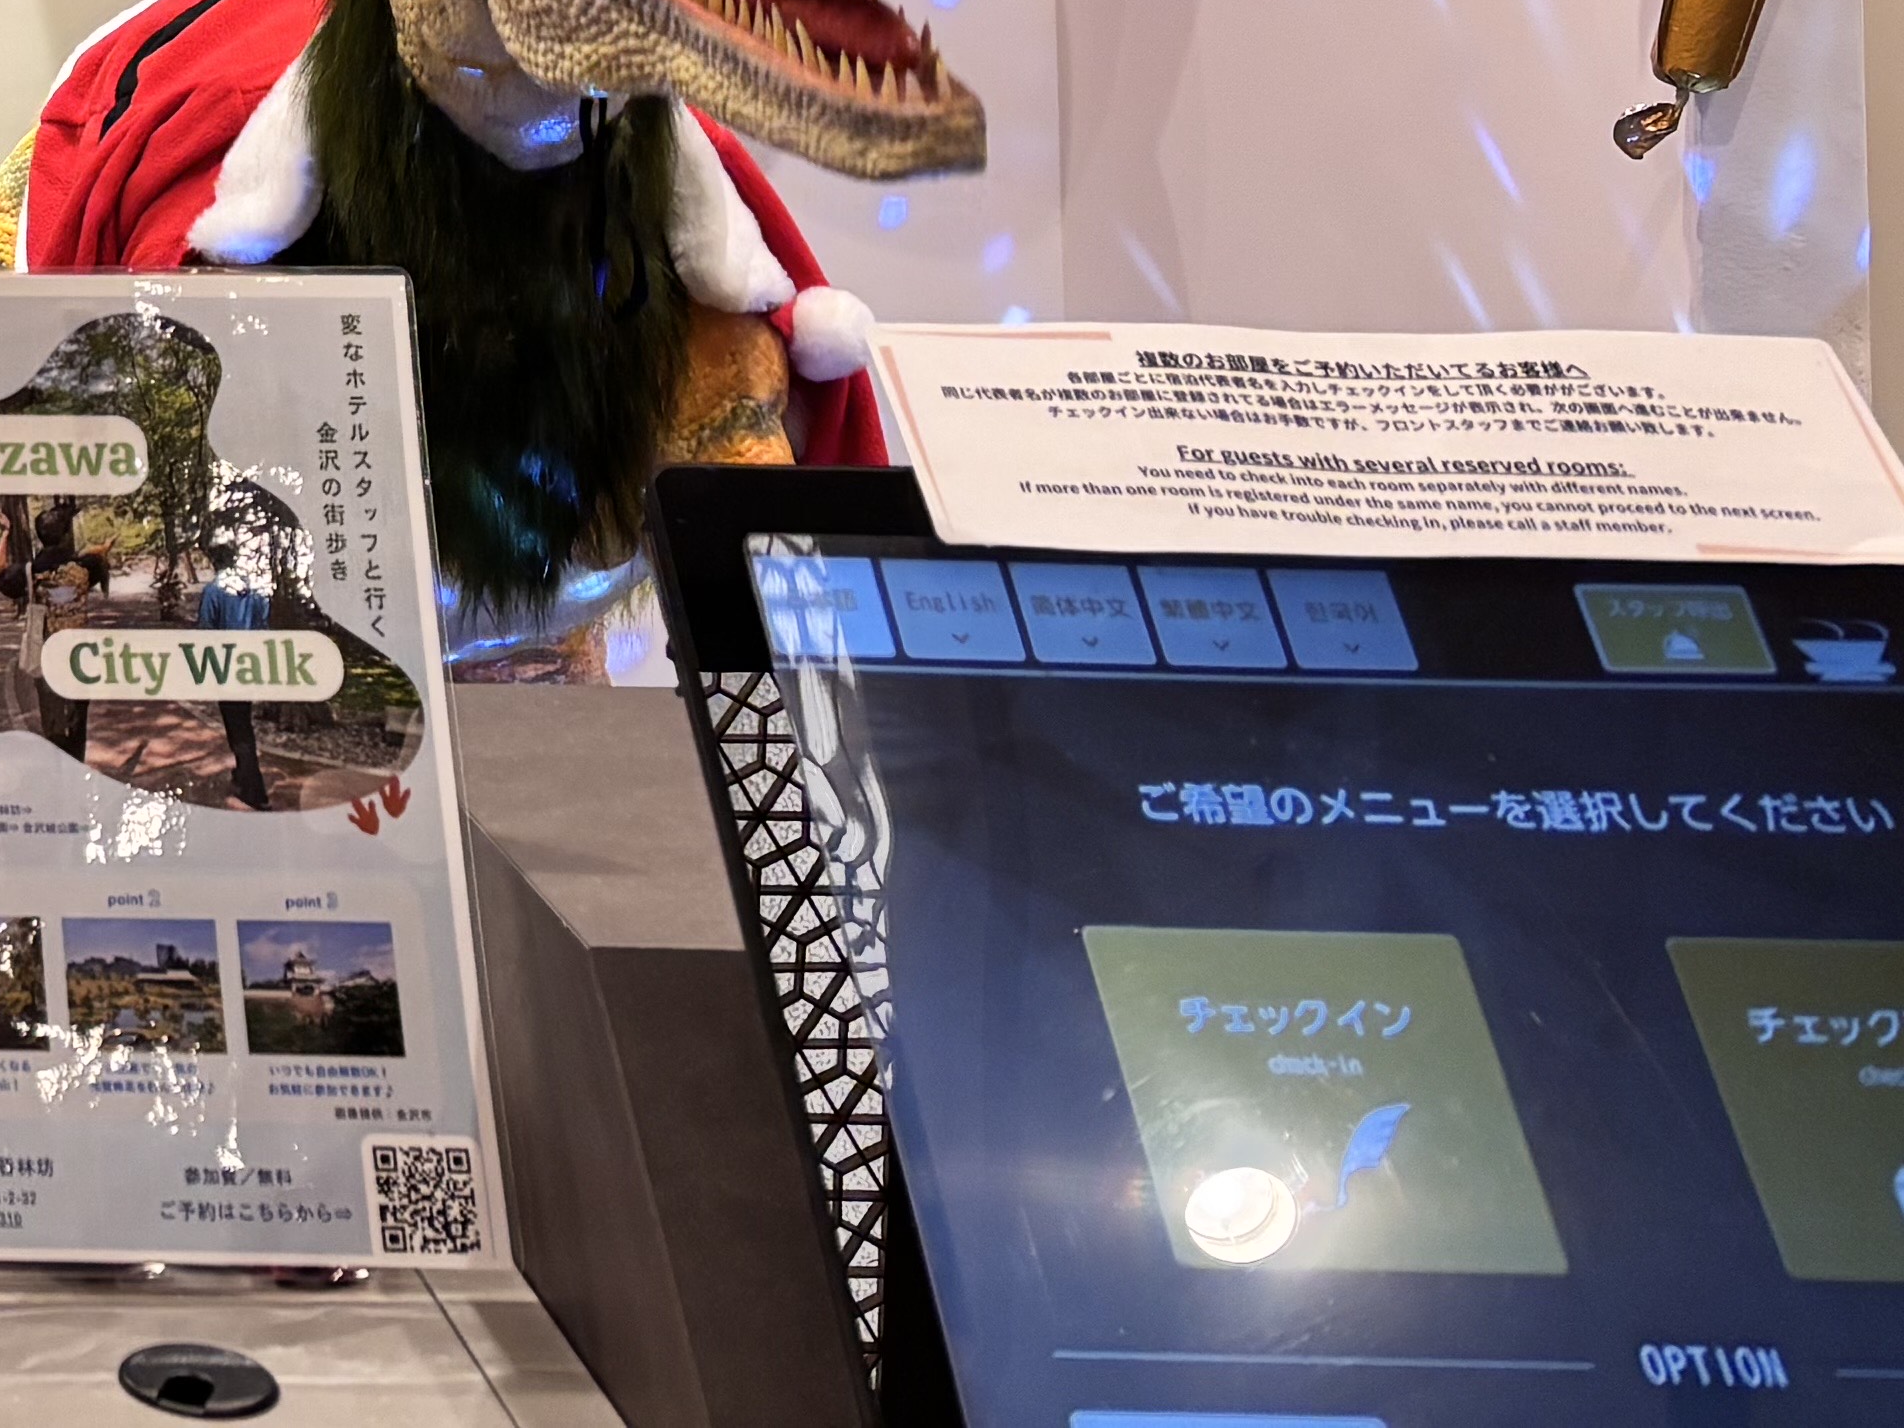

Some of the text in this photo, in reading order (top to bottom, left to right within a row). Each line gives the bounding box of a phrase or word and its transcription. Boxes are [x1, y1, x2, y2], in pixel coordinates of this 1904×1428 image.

[340, 313, 388, 639] 変なホテルスタッフと行く
[1176, 444, 1635, 478] For guests with several reserved rooms:
[316, 421, 349, 582] 金沢の街歩き
[905, 591, 994, 614] English
[1306, 600, 1378, 624] 한국어
[69, 638, 318, 696] City Walk
[1139, 781, 1895, 835] ご希望のメニューを選択してください
[108, 894, 143, 907] point
[285, 897, 321, 910] point
[1180, 997, 1411, 1037] チェックイン
[1640, 1345, 1790, 1393] OPTION
